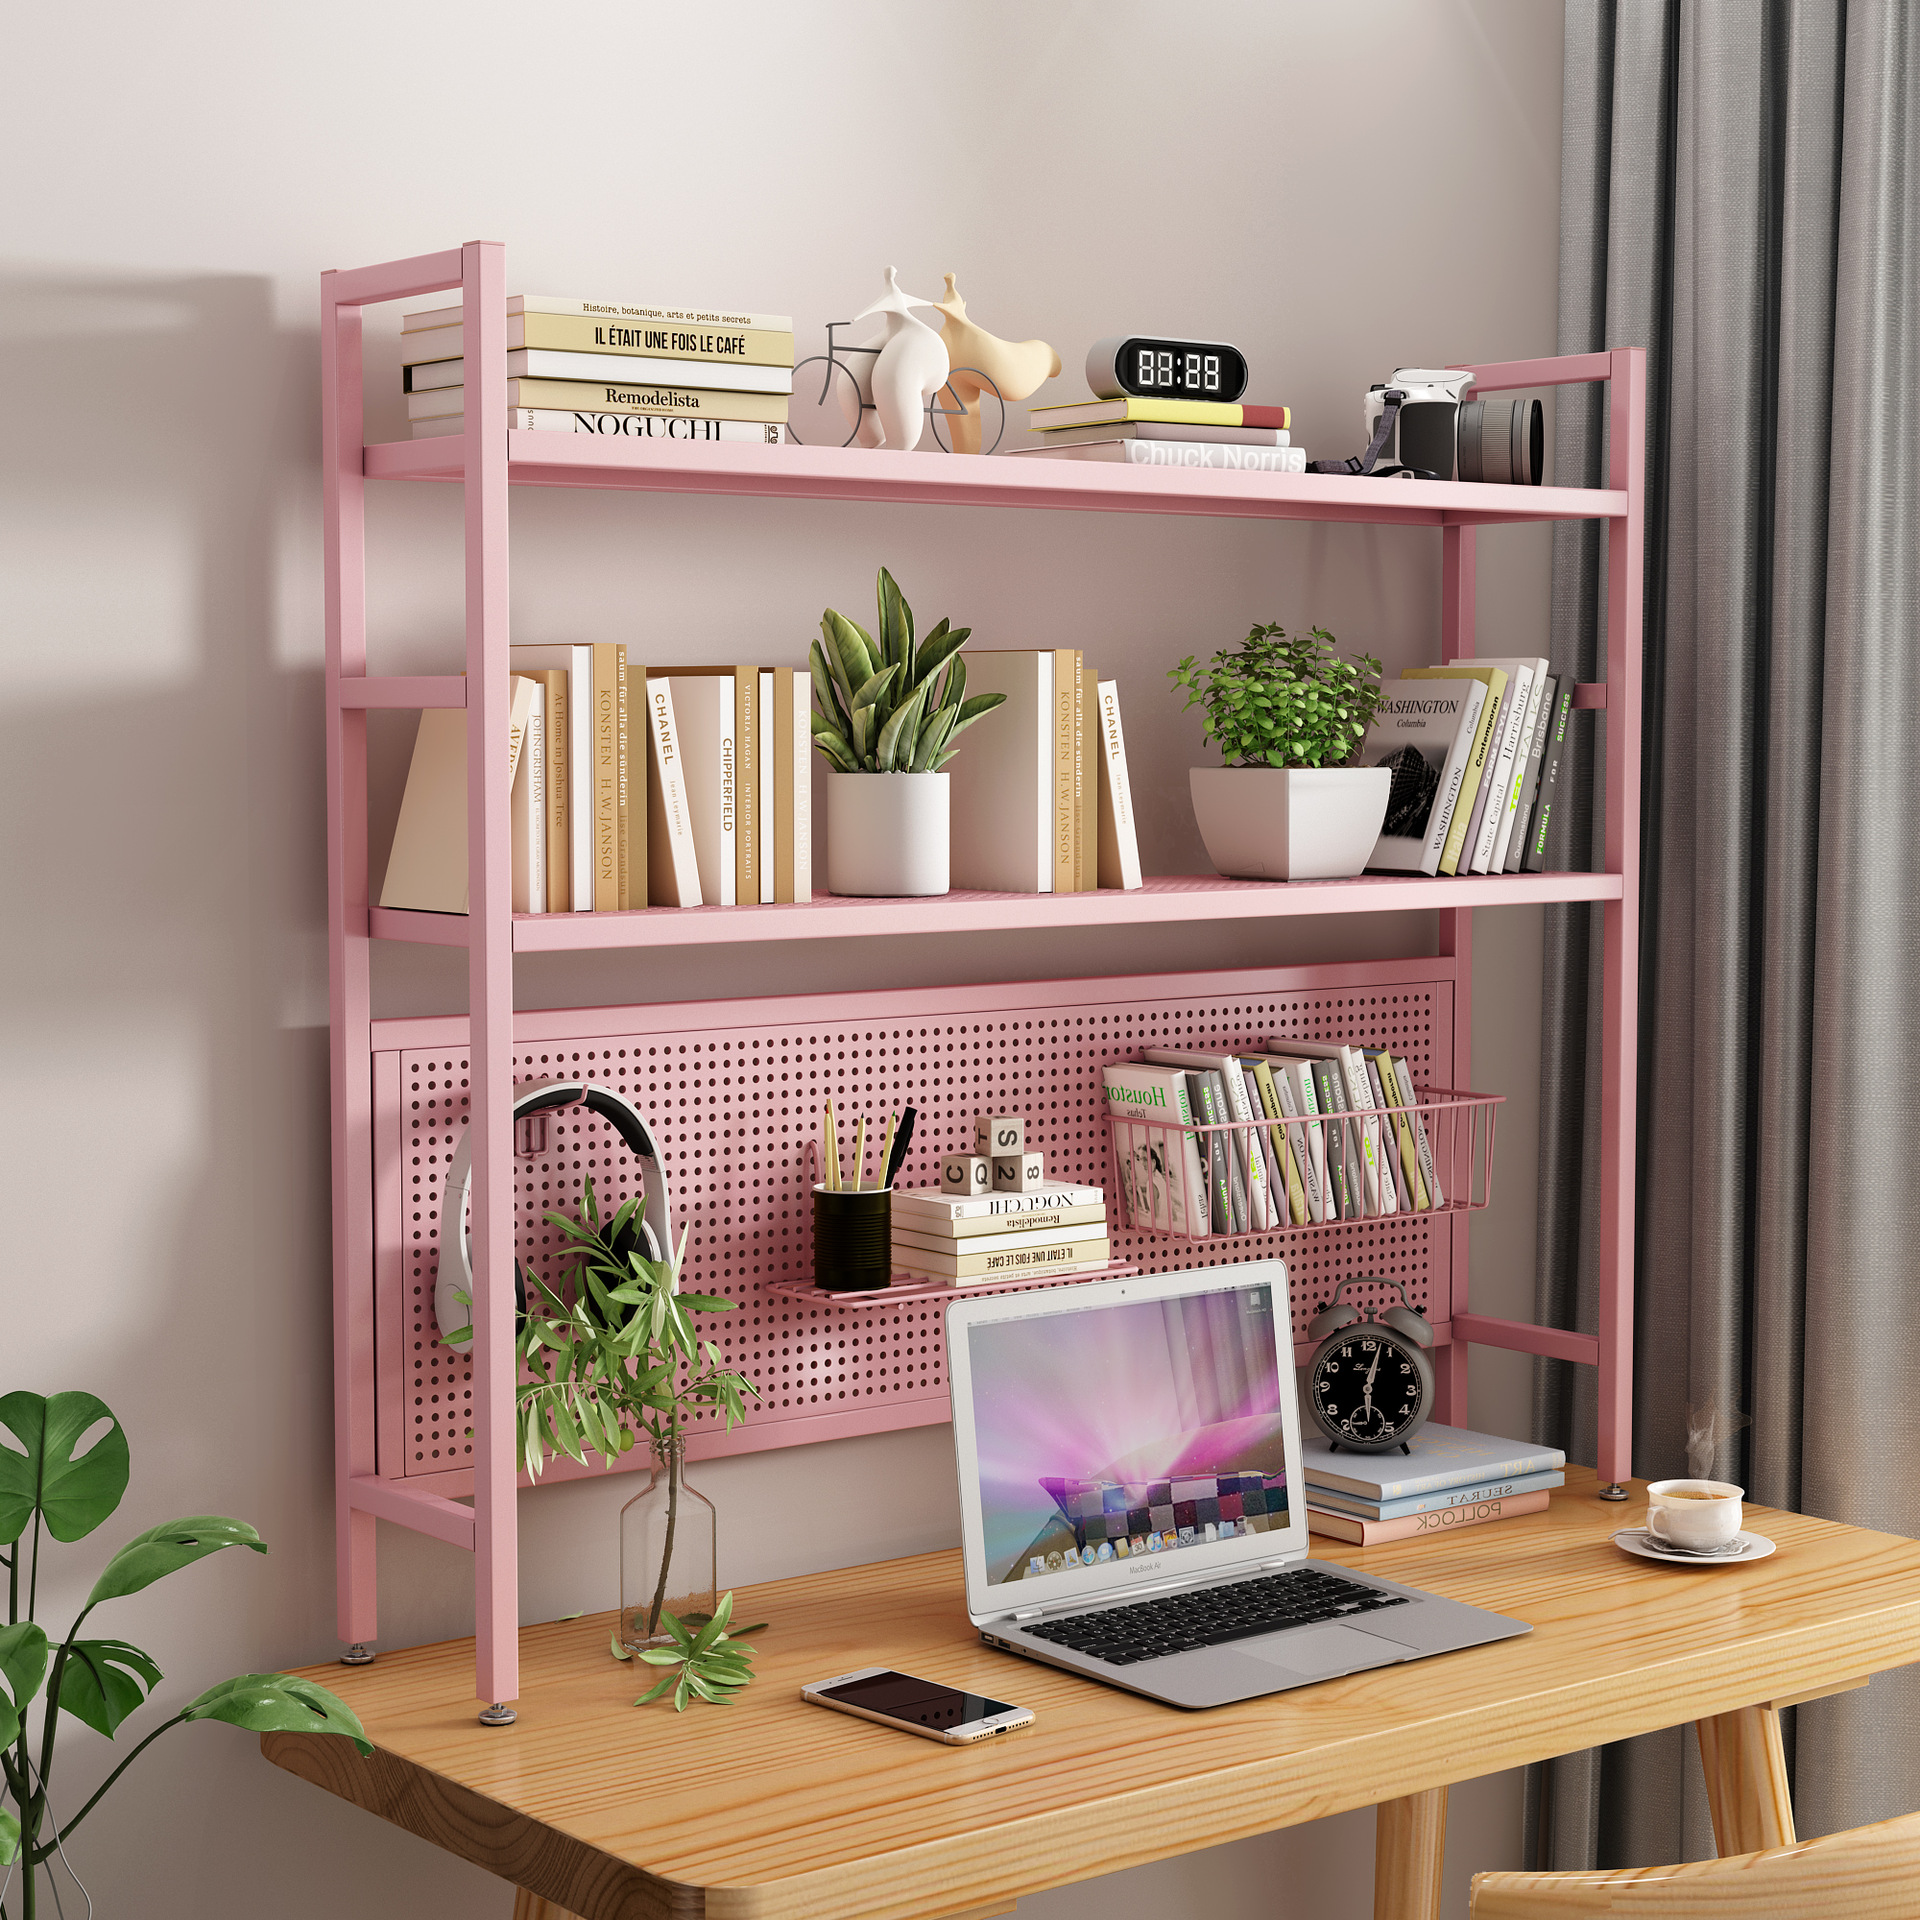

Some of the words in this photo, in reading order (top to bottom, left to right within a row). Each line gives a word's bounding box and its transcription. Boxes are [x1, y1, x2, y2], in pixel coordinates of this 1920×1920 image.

[583, 303, 619, 315] Histoire,
[621, 306, 664, 319] botanique,
[667, 311, 684, 319] arts
[686, 312, 695, 320] et
[696, 313, 720, 322] petits
[721, 315, 751, 325] secrets
[595, 327, 606, 345] IL
[609, 325, 642, 348] ÉTAIT
[645, 330, 668, 350] UNE
[671, 332, 697, 352] FOIS
[700, 334, 714, 353] LE
[716, 334, 745, 355] CAFÉ
[605, 388, 700, 408] Remodelista
[572, 412, 722, 441] NOGUCHI
[1131, 440, 1213, 468] Chuck
[1223, 444, 1301, 473] Norris
[555, 693, 563, 706] At
[619, 686, 627, 704] für
[1377, 700, 1459, 714] WASHINGTON
[619, 707, 627, 728] alla
[1060, 691, 1070, 760] KONSTEN
[1396, 719, 1427, 728] Columbia
[555, 711, 563, 743] Home
[600, 690, 611, 765] KONSTEN
[655, 693, 674, 765] CHANEL
[1104, 695, 1120, 760] CHANEL
[619, 732, 627, 750] die
[1483, 749, 1498, 788] FORM
[1495, 701, 1510, 745] STYLE
[1509, 774, 1522, 812] TED
[1519, 683, 1543, 762] TALKS
[555, 747, 564, 757] in
[1433, 767, 1462, 850] WASHINGTON
[1466, 701, 1480, 734] Columbia
[1482, 824, 1495, 857] State
[1489, 783, 1505, 825] Capital
[1503, 682, 1530, 760] Harrisburg
[1514, 804, 1529, 859] Queensland
[1531, 692, 1551, 758] Brisbane
[1536, 804, 1551, 855] FORMULA
[1549, 760, 1558, 783] FOR
[1556, 693, 1570, 742] SUCCESS
[553, 760, 564, 799] Joshua
[619, 754, 627, 806] sünderin
[723, 738, 733, 831] CHIPPERFIELD
[1446, 821, 1468, 863] Italia
[1475, 696, 1499, 767] Contemporan
[555, 803, 565, 828] Tree
[997, 1129, 1017, 1147] S
[946, 1164, 964, 1184] C
[975, 1163, 988, 1185] Q
[998, 1164, 1015, 1180] 2
[1027, 1165, 1040, 1180] 8
[990, 1193, 1074, 1215] NOGUCHI
[1006, 1214, 1060, 1229] Remodelista
[987, 1256, 1004, 1270] CAFÉ
[1006, 1254, 1014, 1266] LE
[1015, 1253, 1030, 1265] FOIS
[1032, 1251, 1046, 1263] UNE
[1047, 1249, 1066, 1262] ÉTAIT
[1341, 1347, 1352, 1357] 11
[1361, 1341, 1377, 1351] 12
[1386, 1347, 1393, 1358] 1
[1325, 1362, 1339, 1373] 10
[1400, 1363, 1411, 1374] 2
[1320, 1381, 1331, 1392] 9
[1406, 1385, 1417, 1396] 3
[1327, 1404, 1338, 1415] 8
[1398, 1404, 1410, 1415] 4
[1384, 1421, 1395, 1432] 5
[1129, 1563, 1154, 1575] MacBook
[1154, 1562, 1162, 1570] Air
